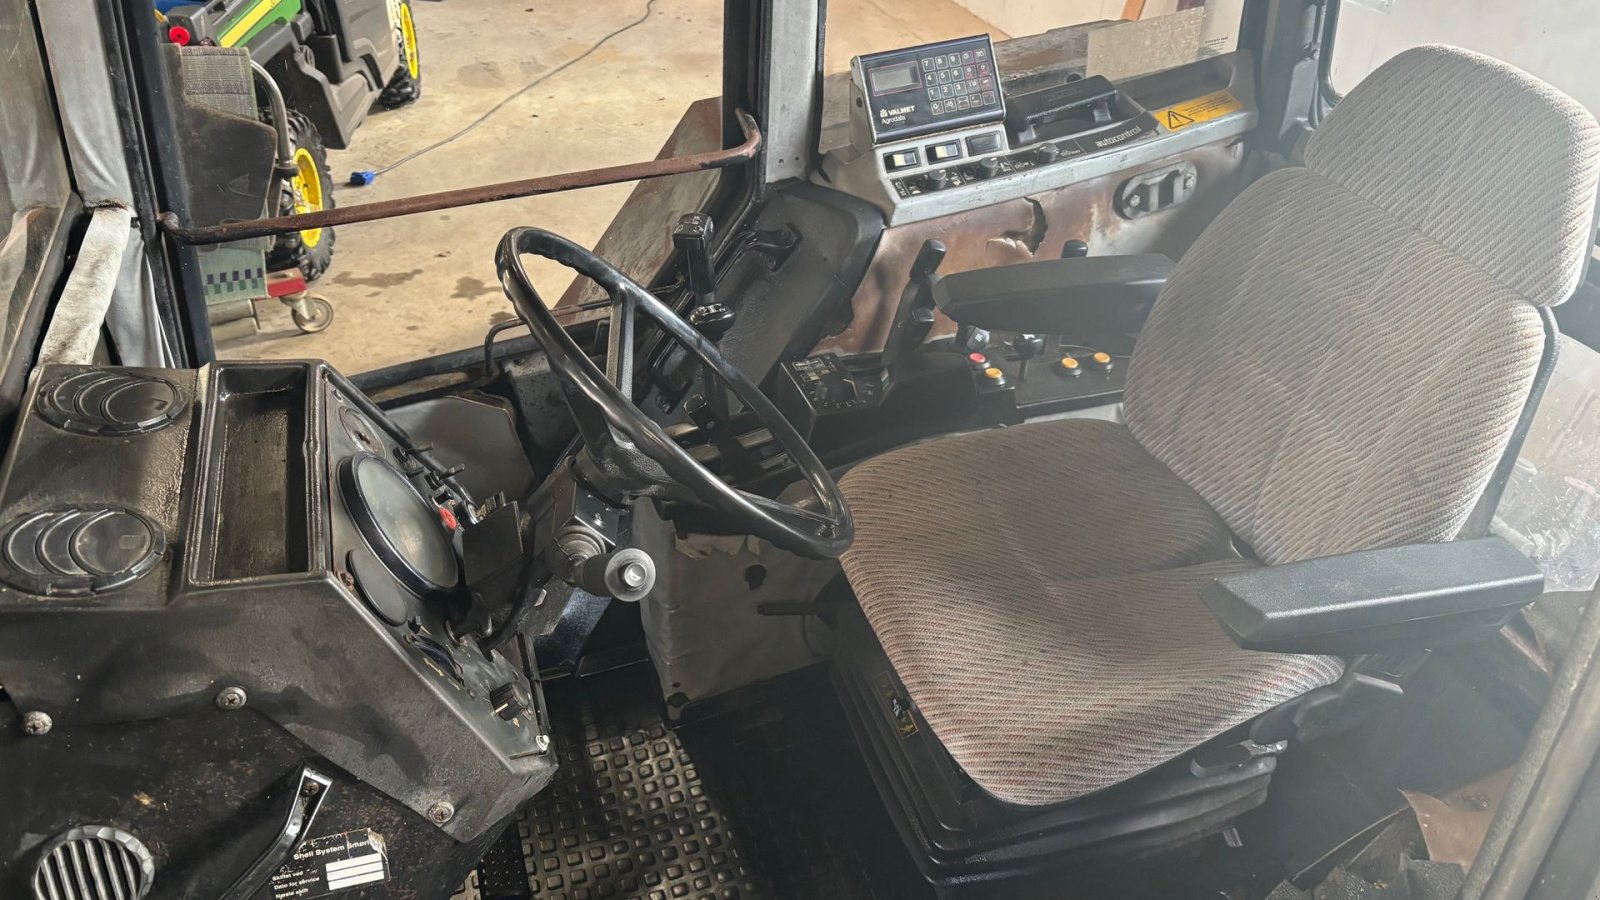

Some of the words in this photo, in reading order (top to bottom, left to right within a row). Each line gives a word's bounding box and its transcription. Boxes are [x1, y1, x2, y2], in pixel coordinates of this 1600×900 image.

[888, 105, 915, 116] VALMET
[881, 115, 906, 125] Agrodata
[1095, 125, 1142, 148] autocontrol
[293, 851, 314, 861] Shell
[315, 845, 345, 857] System
[298, 877, 320, 885] service
